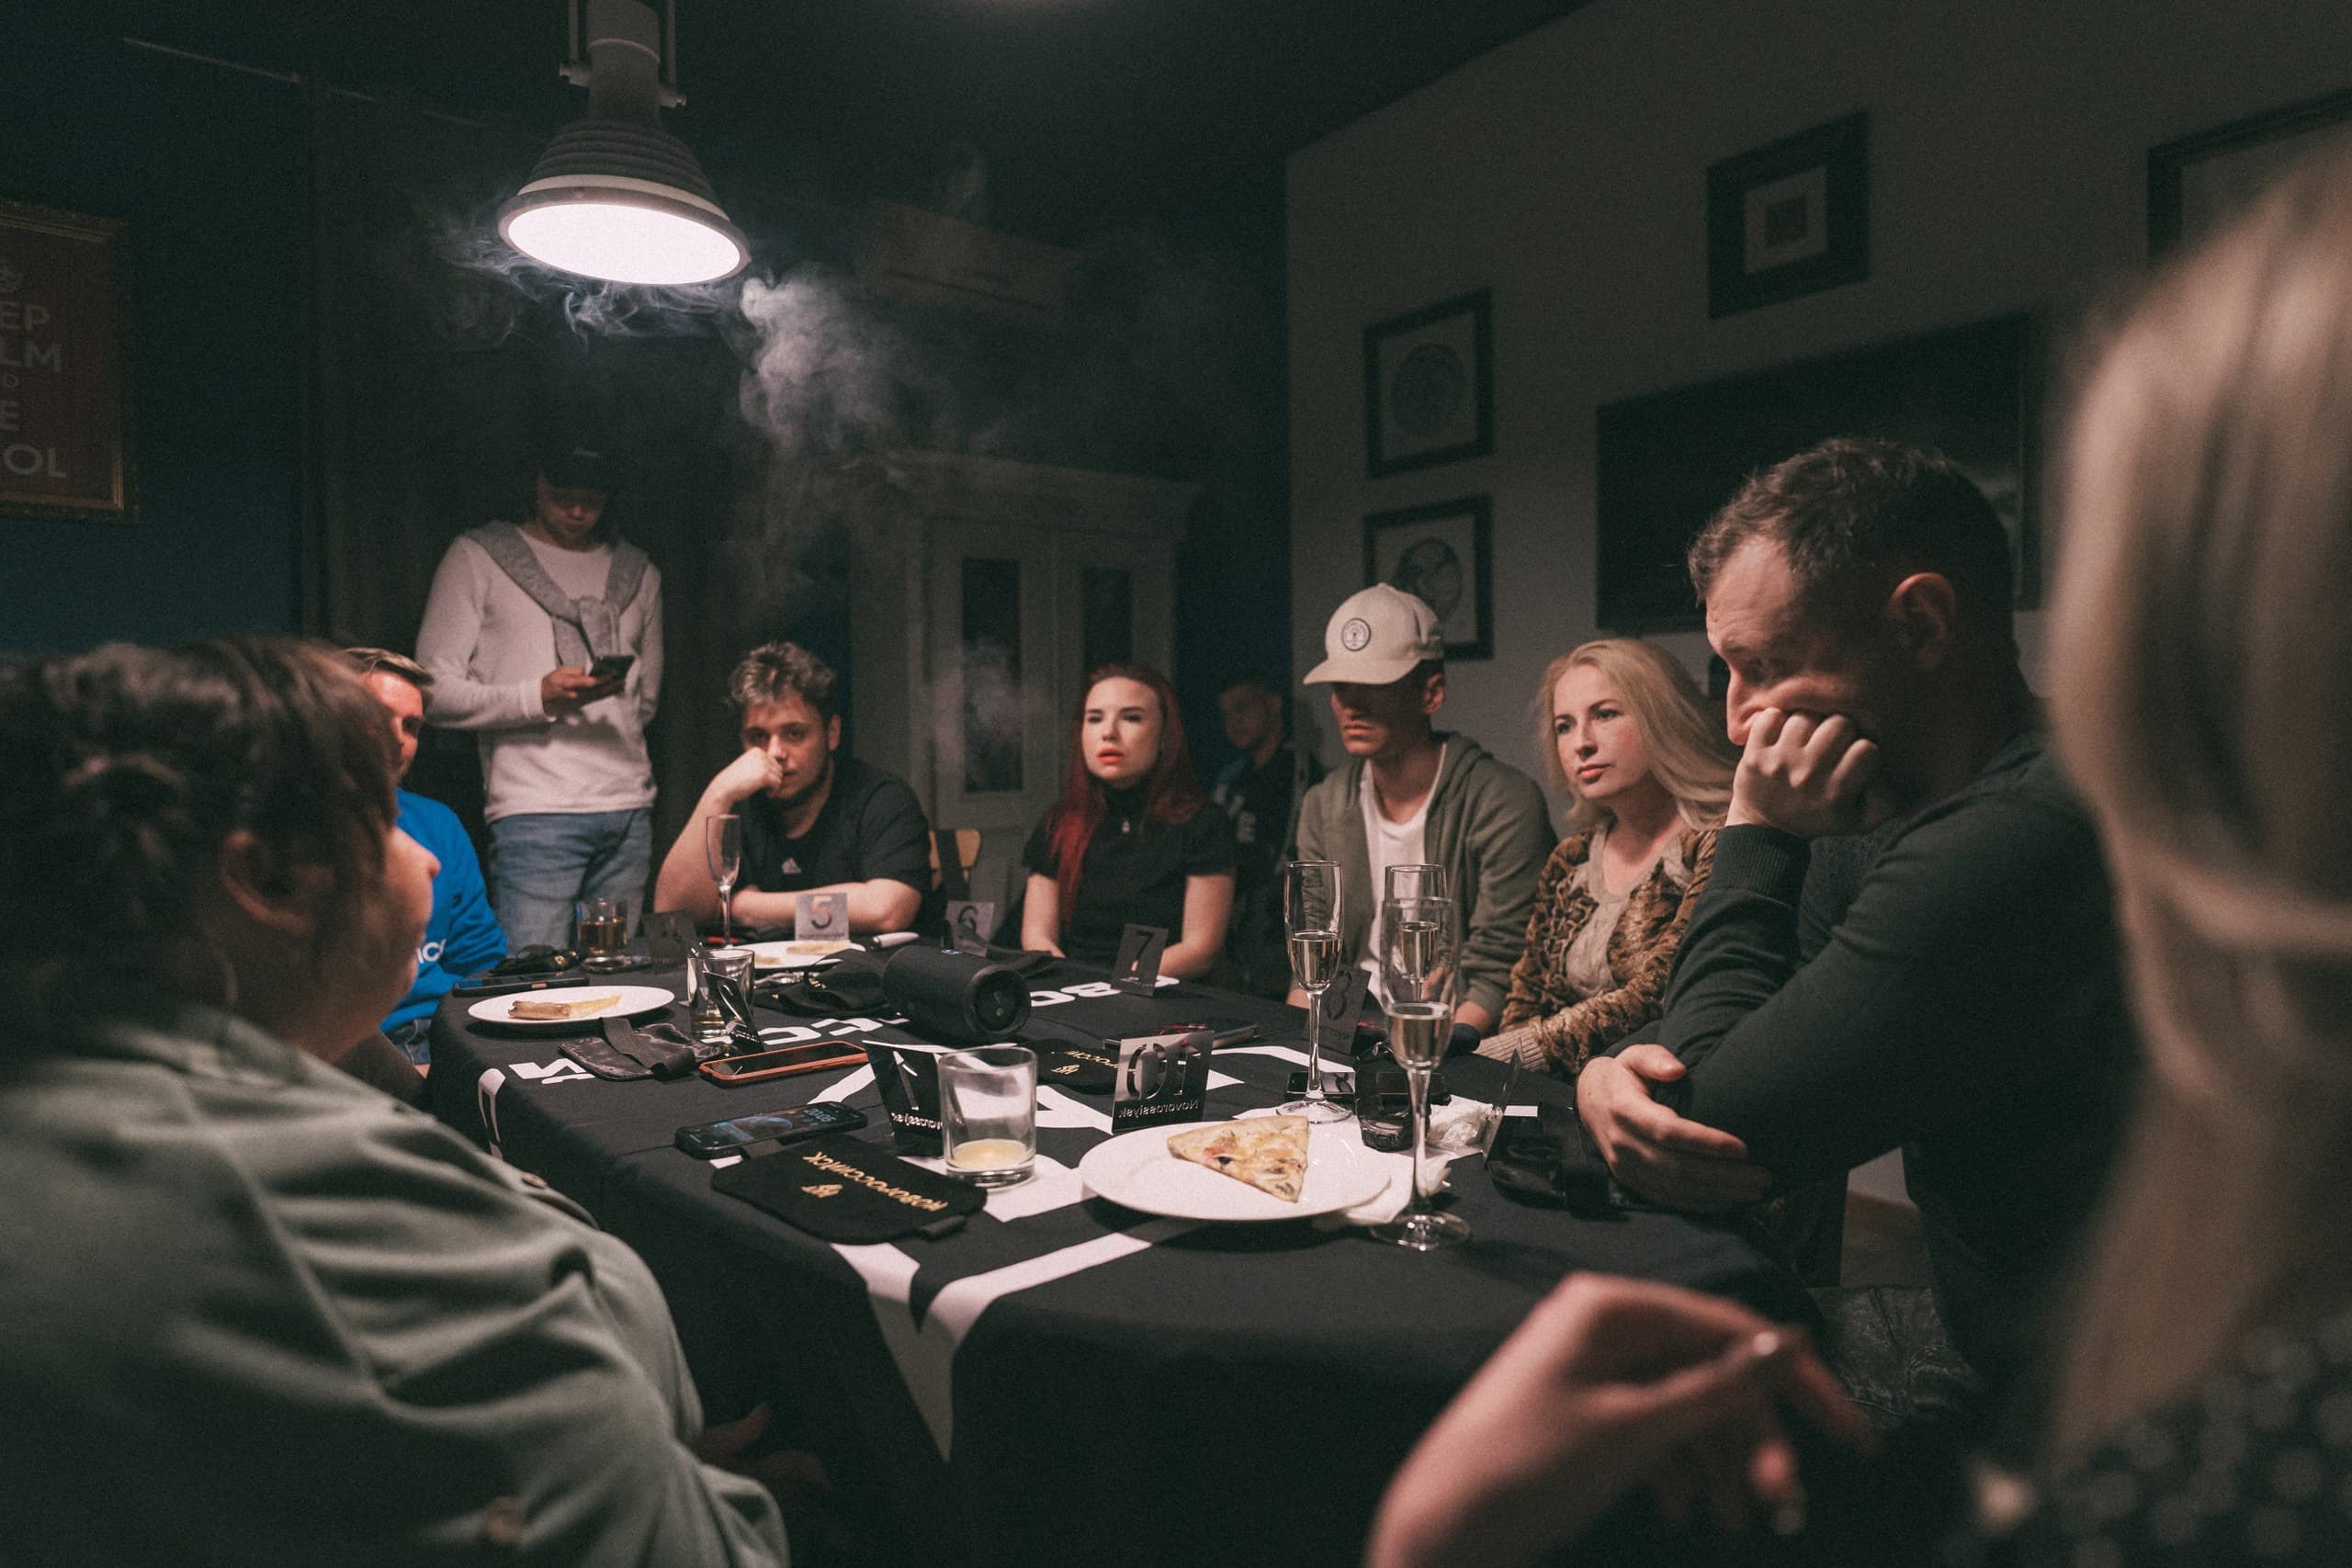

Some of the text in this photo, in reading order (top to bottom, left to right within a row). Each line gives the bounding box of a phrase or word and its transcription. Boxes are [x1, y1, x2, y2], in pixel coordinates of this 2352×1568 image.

[0, 300, 51, 333] EP
[0, 336, 62, 374] LM
[0, 399, 20, 432] E
[3, 442, 68, 479] OL
[809, 895, 833, 930] 5
[1129, 929, 1156, 973] 7
